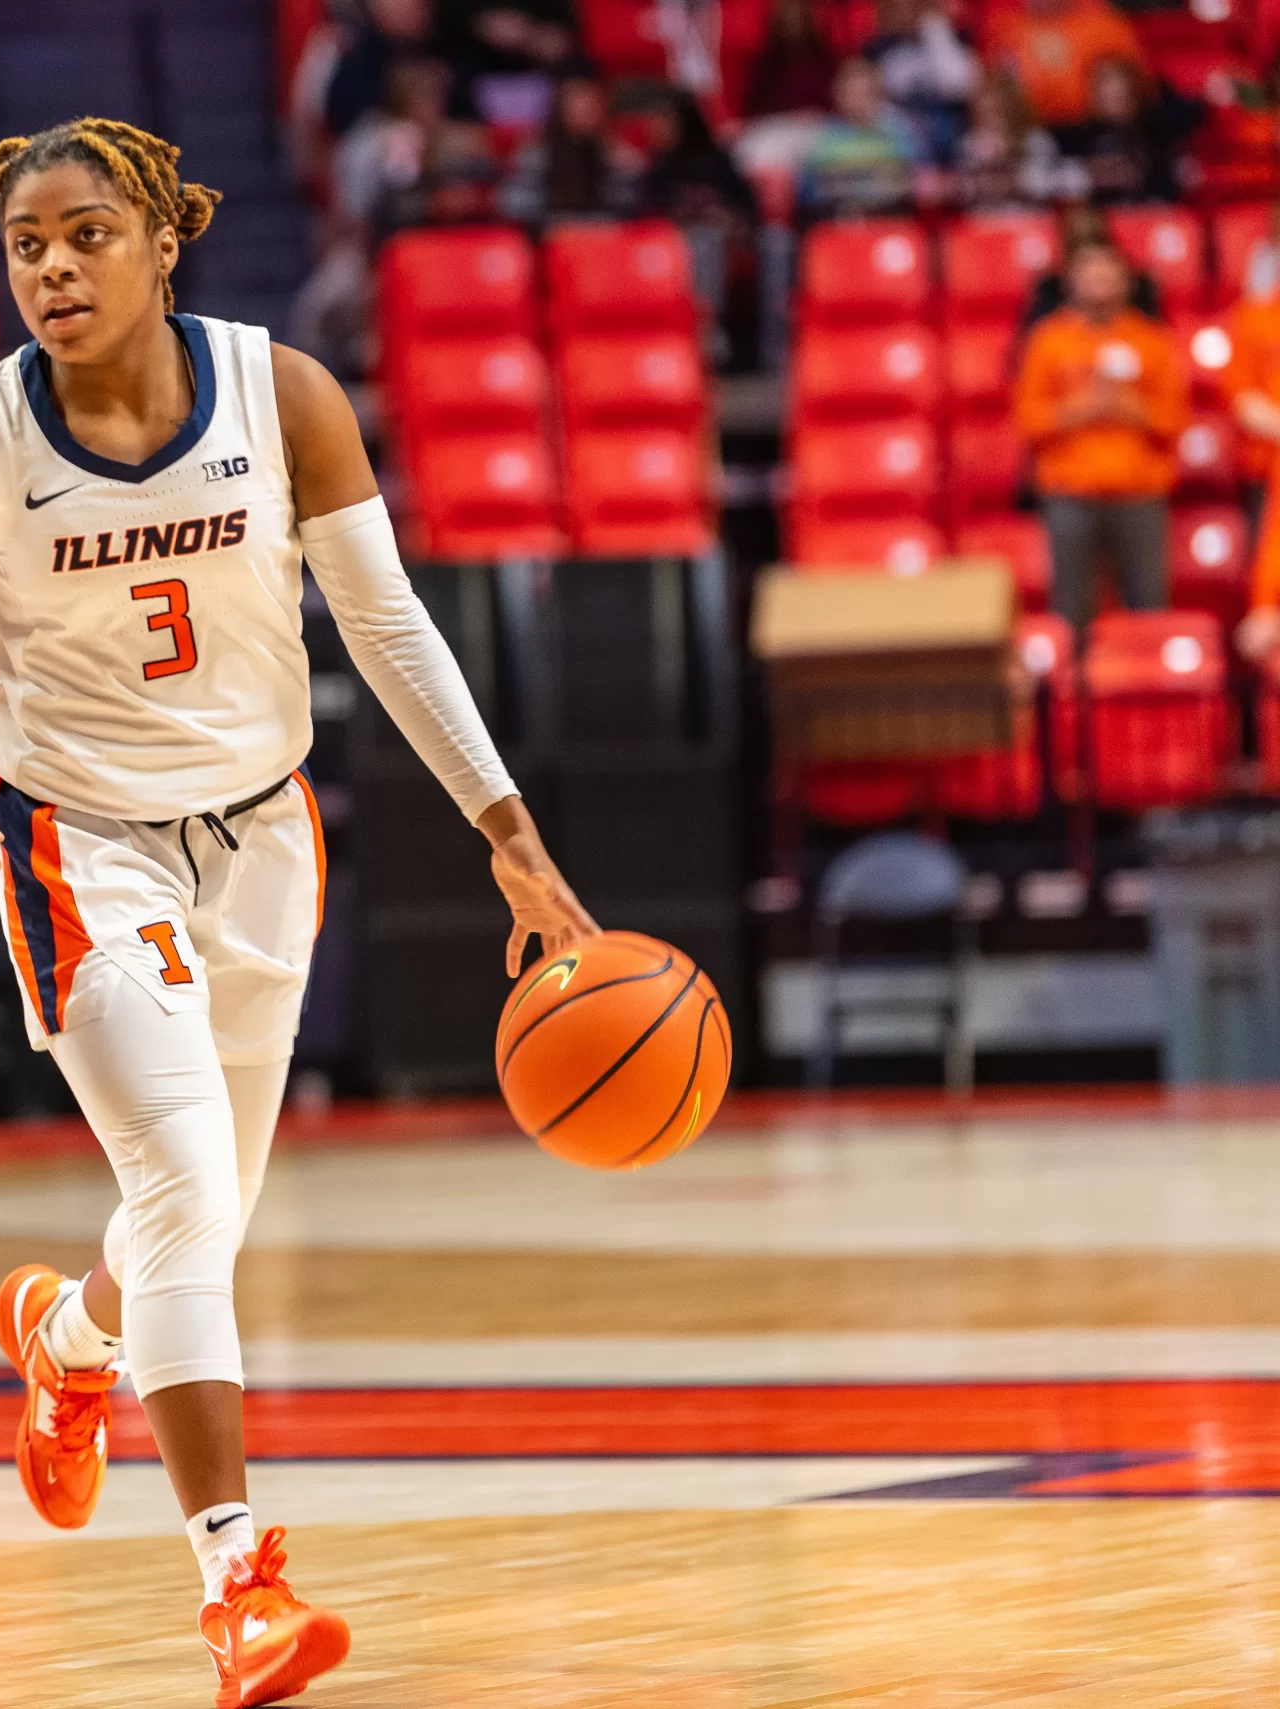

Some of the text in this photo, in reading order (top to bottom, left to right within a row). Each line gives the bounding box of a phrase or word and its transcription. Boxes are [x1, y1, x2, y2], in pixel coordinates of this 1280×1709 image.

[52, 508, 248, 573] ILLINOIS
[130, 578, 198, 681] 3
[136, 920, 194, 985] I
